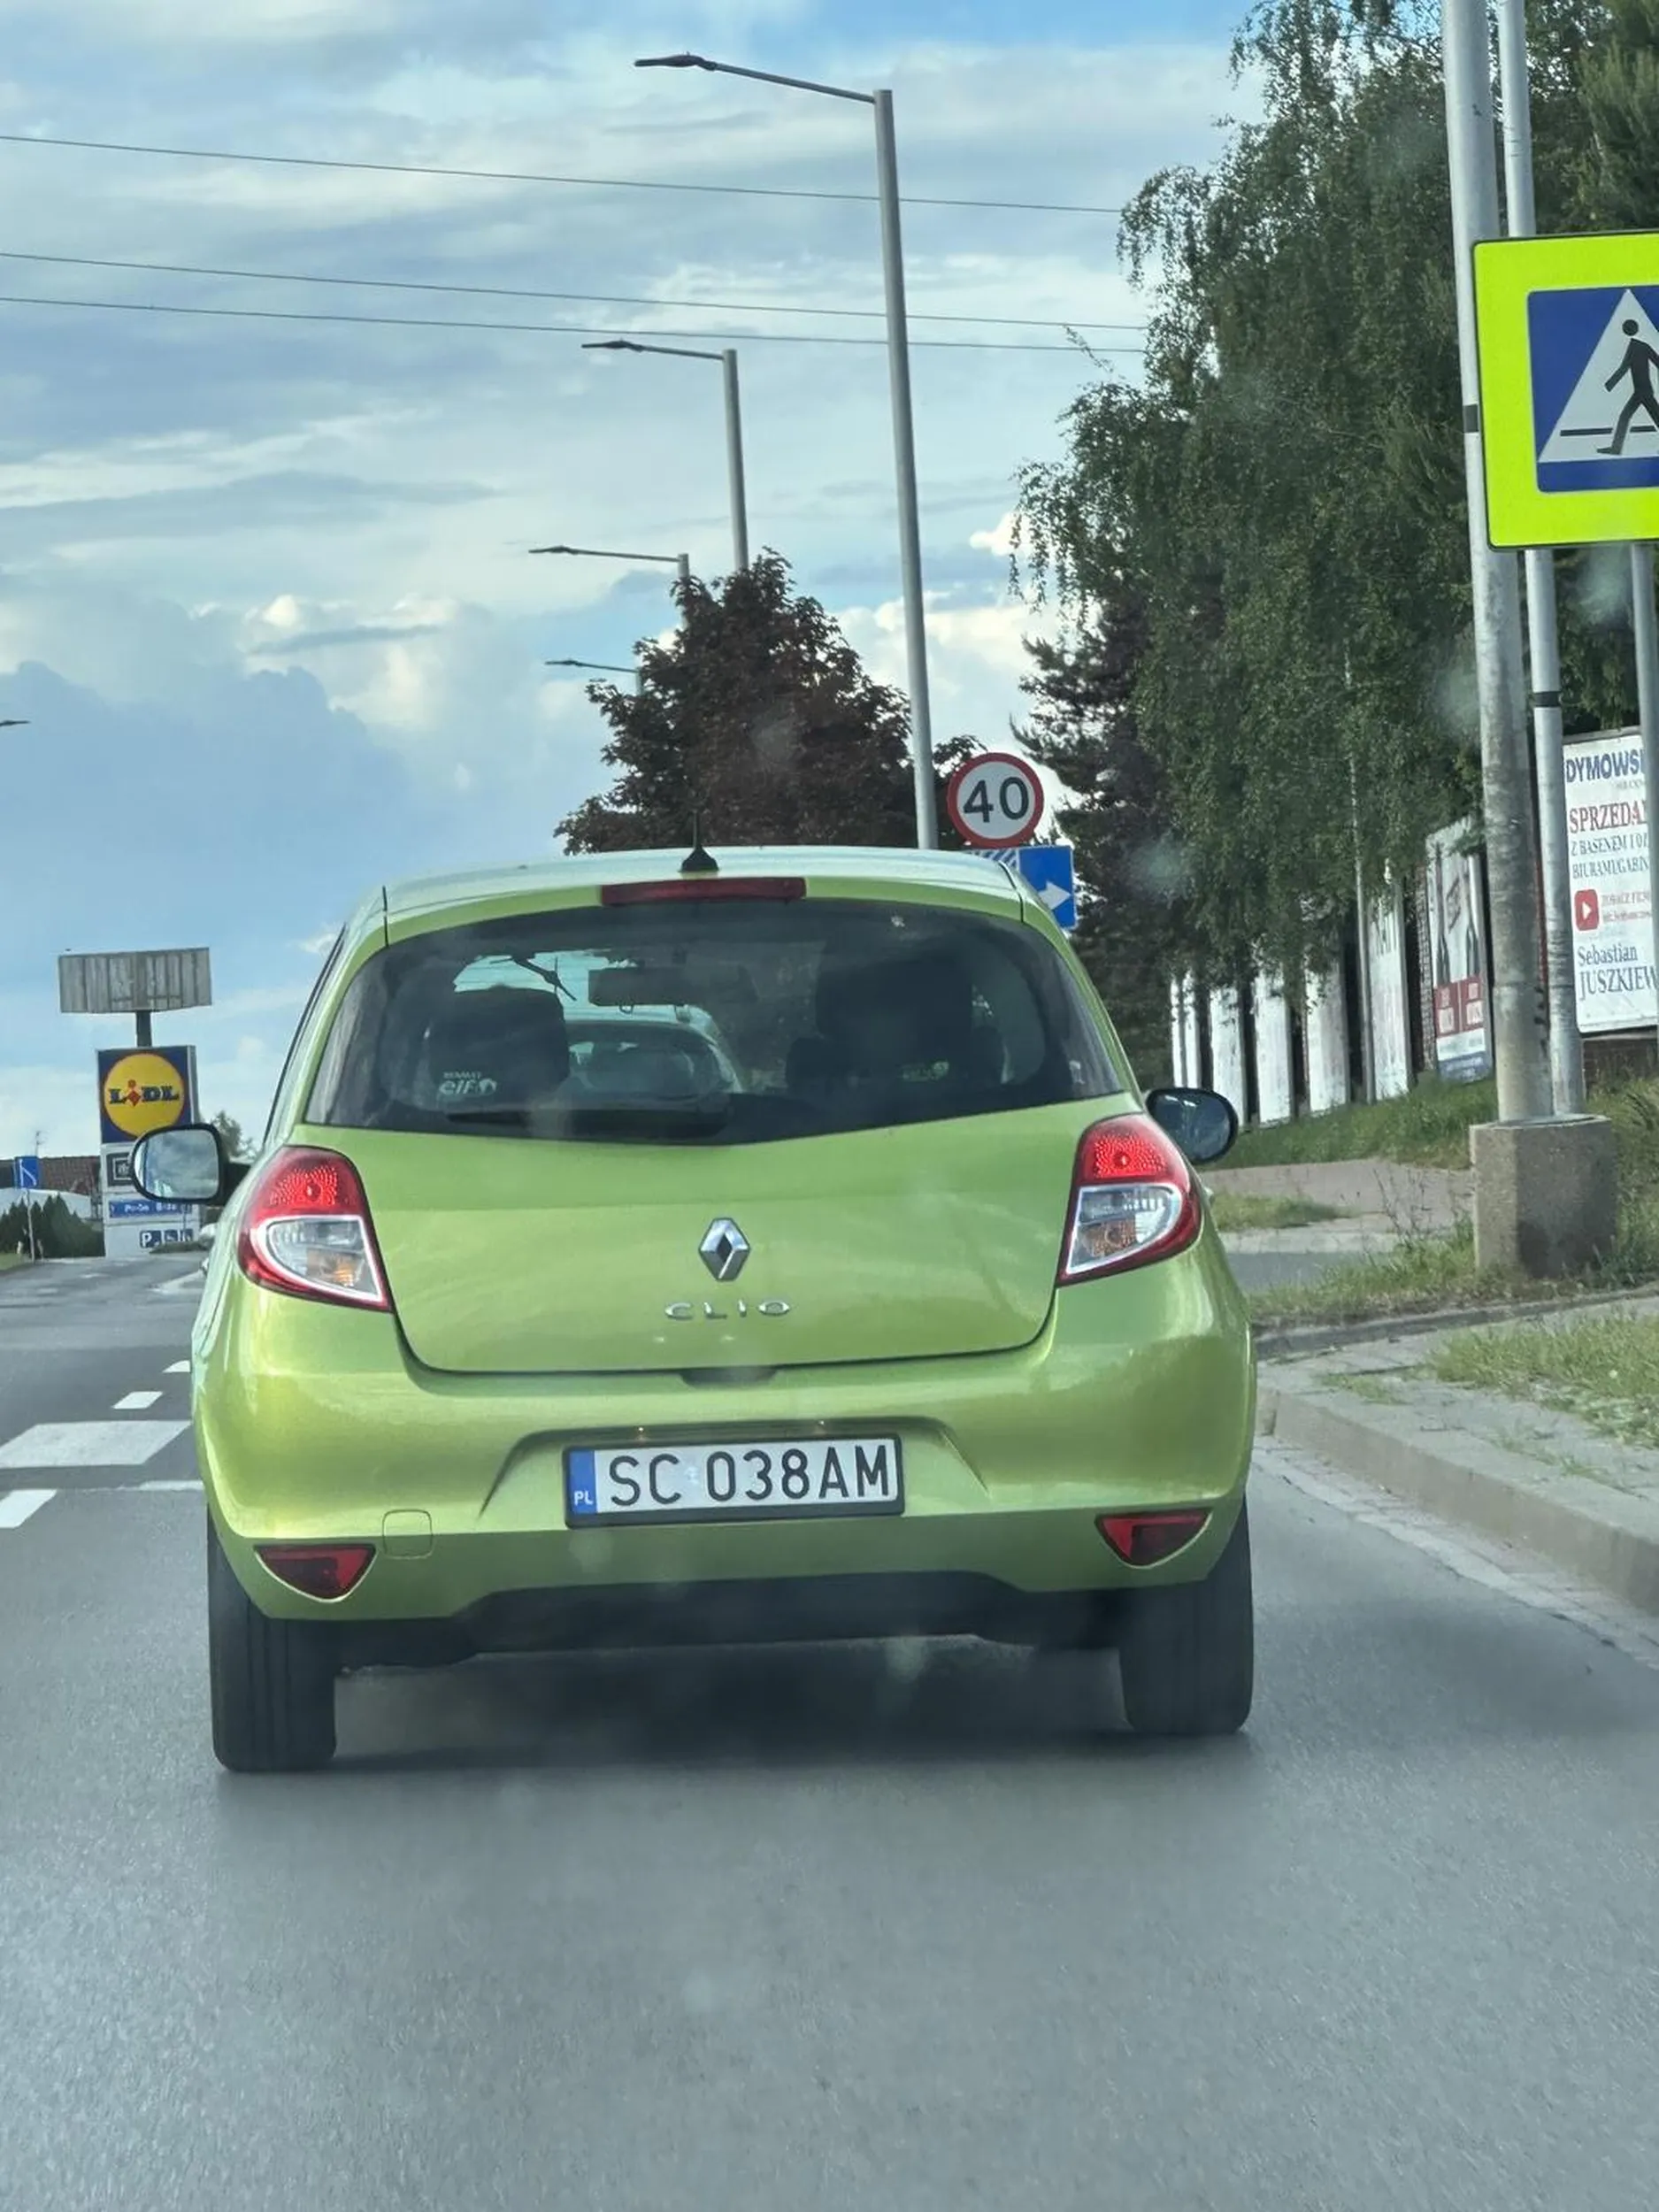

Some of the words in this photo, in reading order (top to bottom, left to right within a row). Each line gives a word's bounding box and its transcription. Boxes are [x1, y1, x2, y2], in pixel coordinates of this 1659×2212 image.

[964, 777, 1029, 823] 40
[1578, 943, 1638, 966] Sebastian
[665, 1299, 790, 1319] CLIO
[609, 1454, 681, 1506] SC
[707, 1445, 889, 1502] 038AM
[574, 1490, 594, 1506] PL
